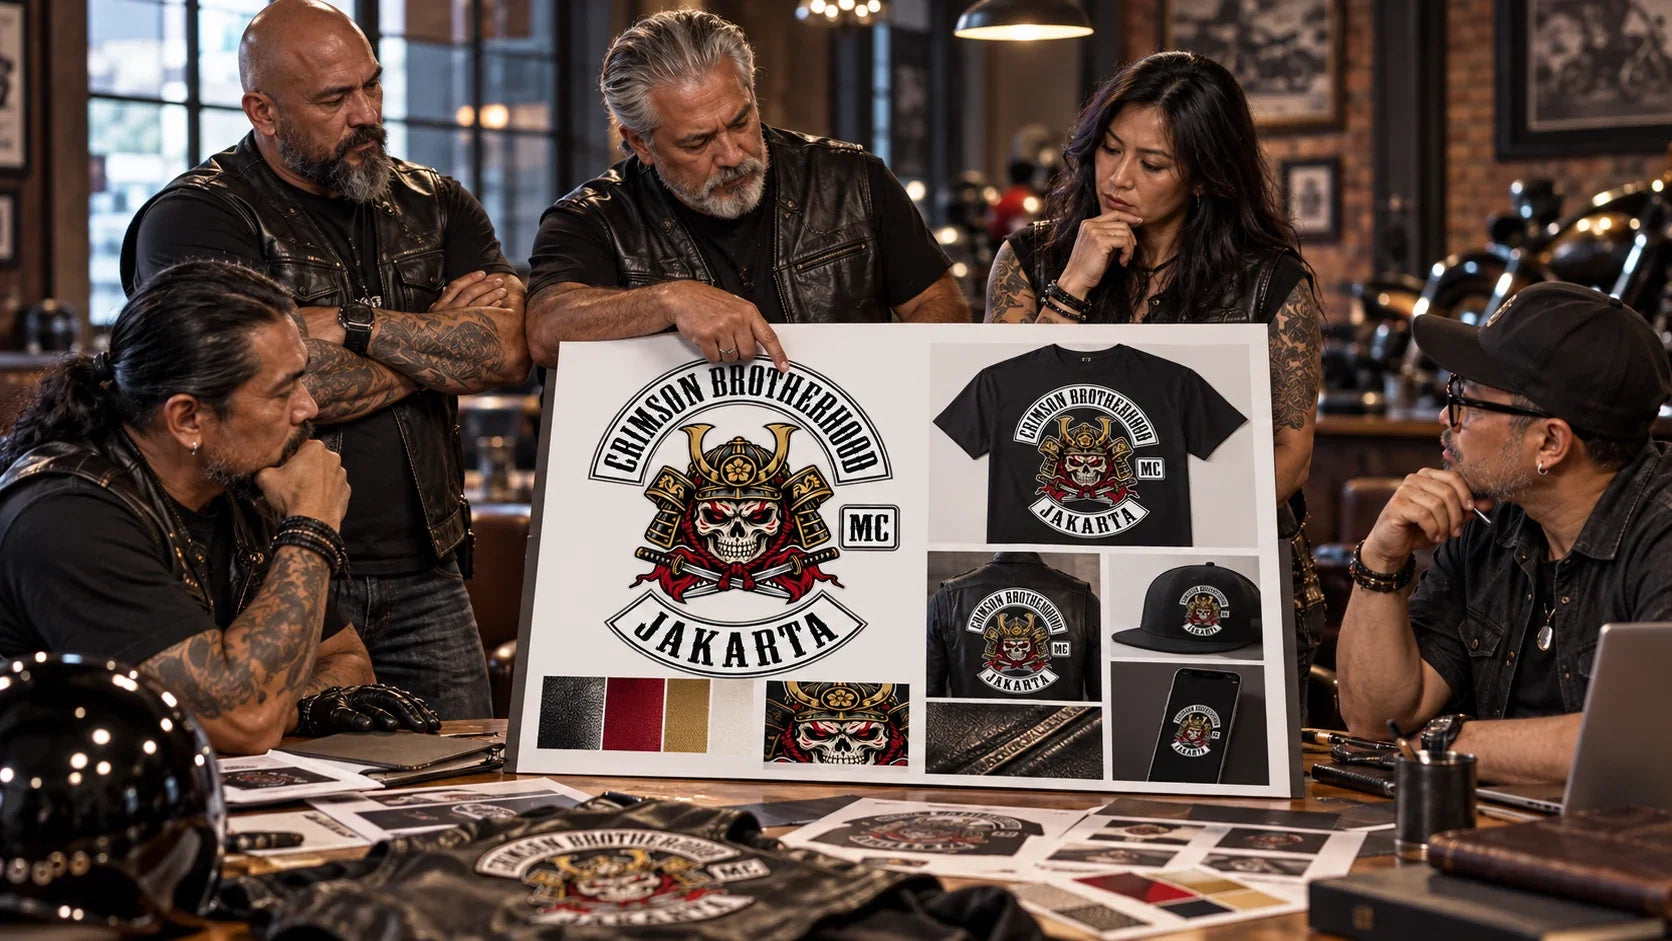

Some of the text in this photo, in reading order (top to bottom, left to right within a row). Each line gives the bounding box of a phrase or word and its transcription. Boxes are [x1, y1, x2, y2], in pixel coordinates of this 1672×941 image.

[603, 364, 879, 474] CRIMSON BROTHERHOOD
[1019, 392, 1067, 440] CRIMSON
[1140, 461, 1161, 477] MC
[849, 513, 889, 542] MC
[1039, 505, 1138, 534] JAKARTA
[633, 610, 839, 668] JAKARTA
[985, 673, 1050, 691] JAKARTA
[566, 831, 726, 856] BROTHER
